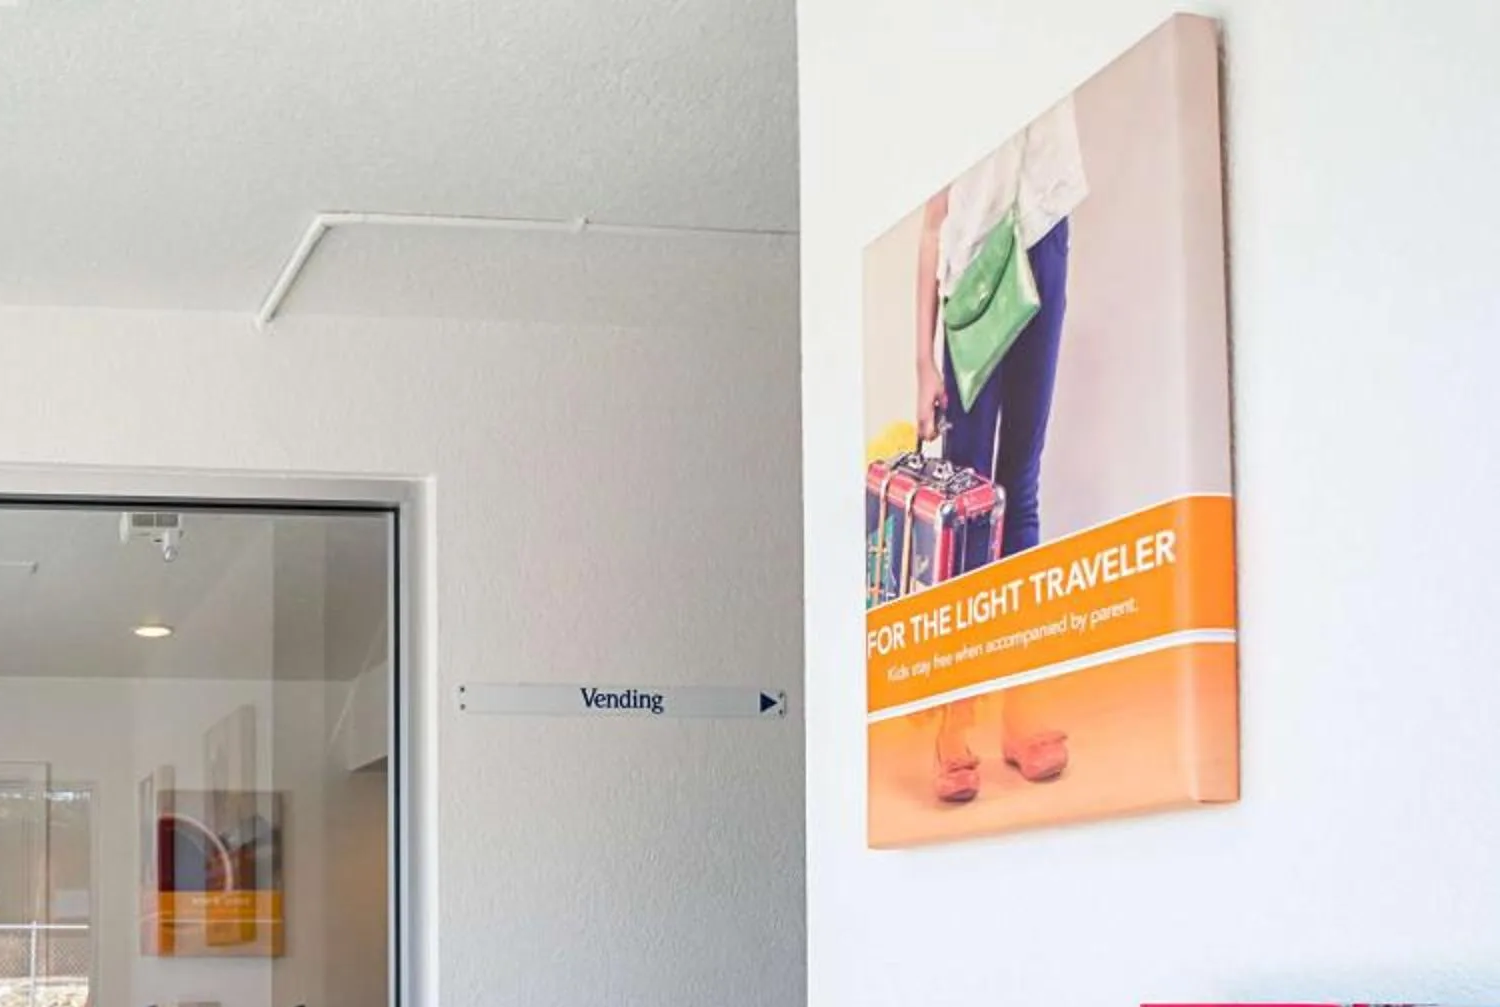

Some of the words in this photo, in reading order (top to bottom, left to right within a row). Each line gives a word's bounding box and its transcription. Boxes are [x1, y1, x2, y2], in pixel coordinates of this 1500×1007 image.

[866, 623, 906, 660] FOR
[910, 605, 951, 642] THE
[956, 579, 1026, 630] LIGHT
[1030, 529, 1177, 606] TRAVELER
[887, 663, 909, 684] Kids
[911, 659, 931, 680] stay
[933, 648, 953, 670] free
[955, 643, 983, 666] when
[985, 619, 1068, 656] accompanied
[1071, 613, 1088, 634] by
[580, 687, 665, 714] Vending
